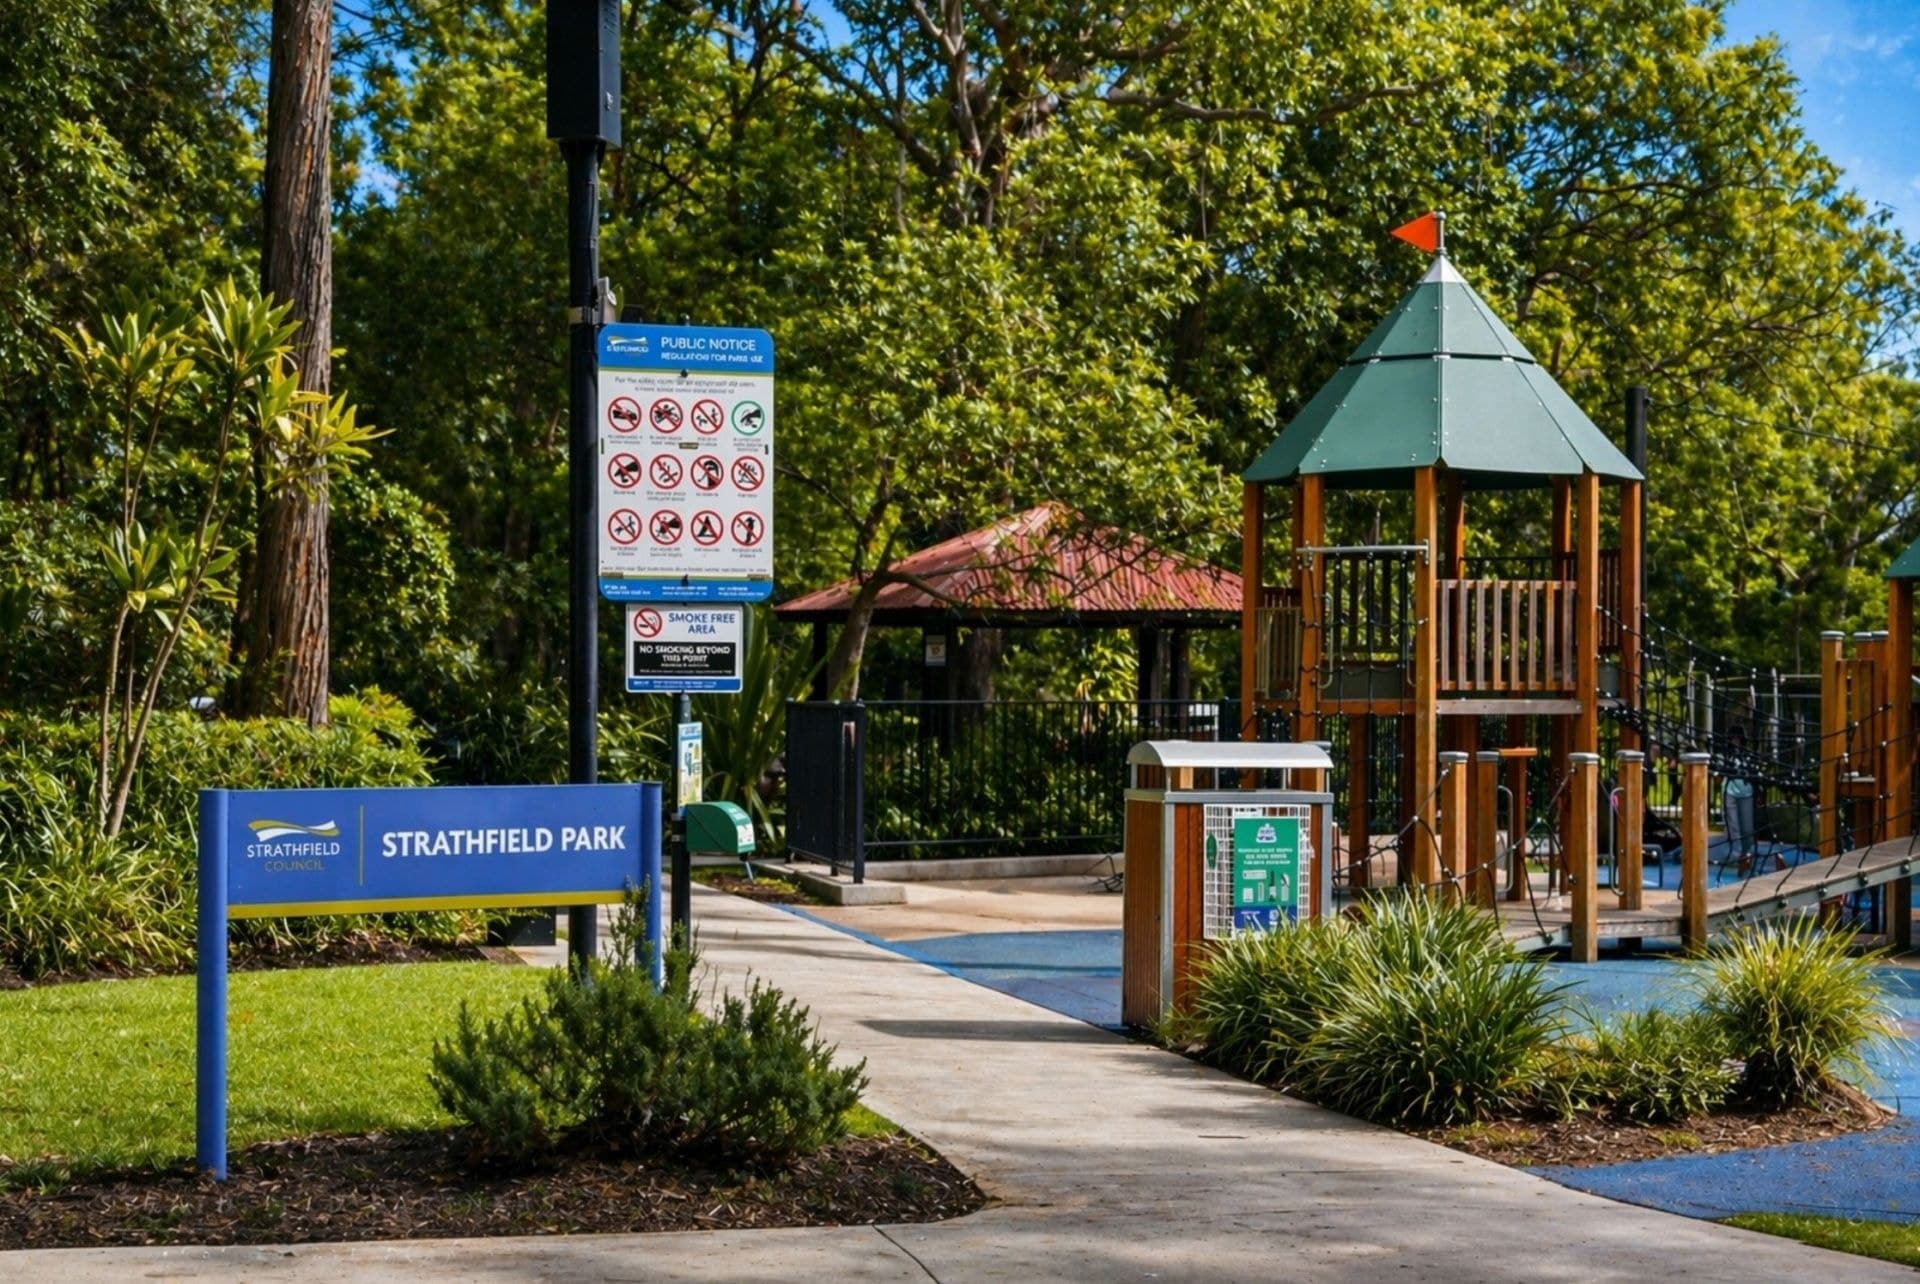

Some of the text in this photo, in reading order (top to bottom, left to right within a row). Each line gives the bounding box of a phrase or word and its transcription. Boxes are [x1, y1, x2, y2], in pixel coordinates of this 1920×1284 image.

[661, 336, 706, 349] PUBLIC
[709, 338, 756, 351] NOTICE
[668, 612, 736, 624] SMOKE FREE
[688, 624, 716, 634] AREA
[639, 645, 731, 654] NO SMOKING BEYOND
[662, 654, 708, 662] THIS POINT
[382, 825, 626, 858] STRATHFIELD PARK
[246, 842, 341, 858] STRATHFIELD
[264, 859, 325, 872] COUNCIL
